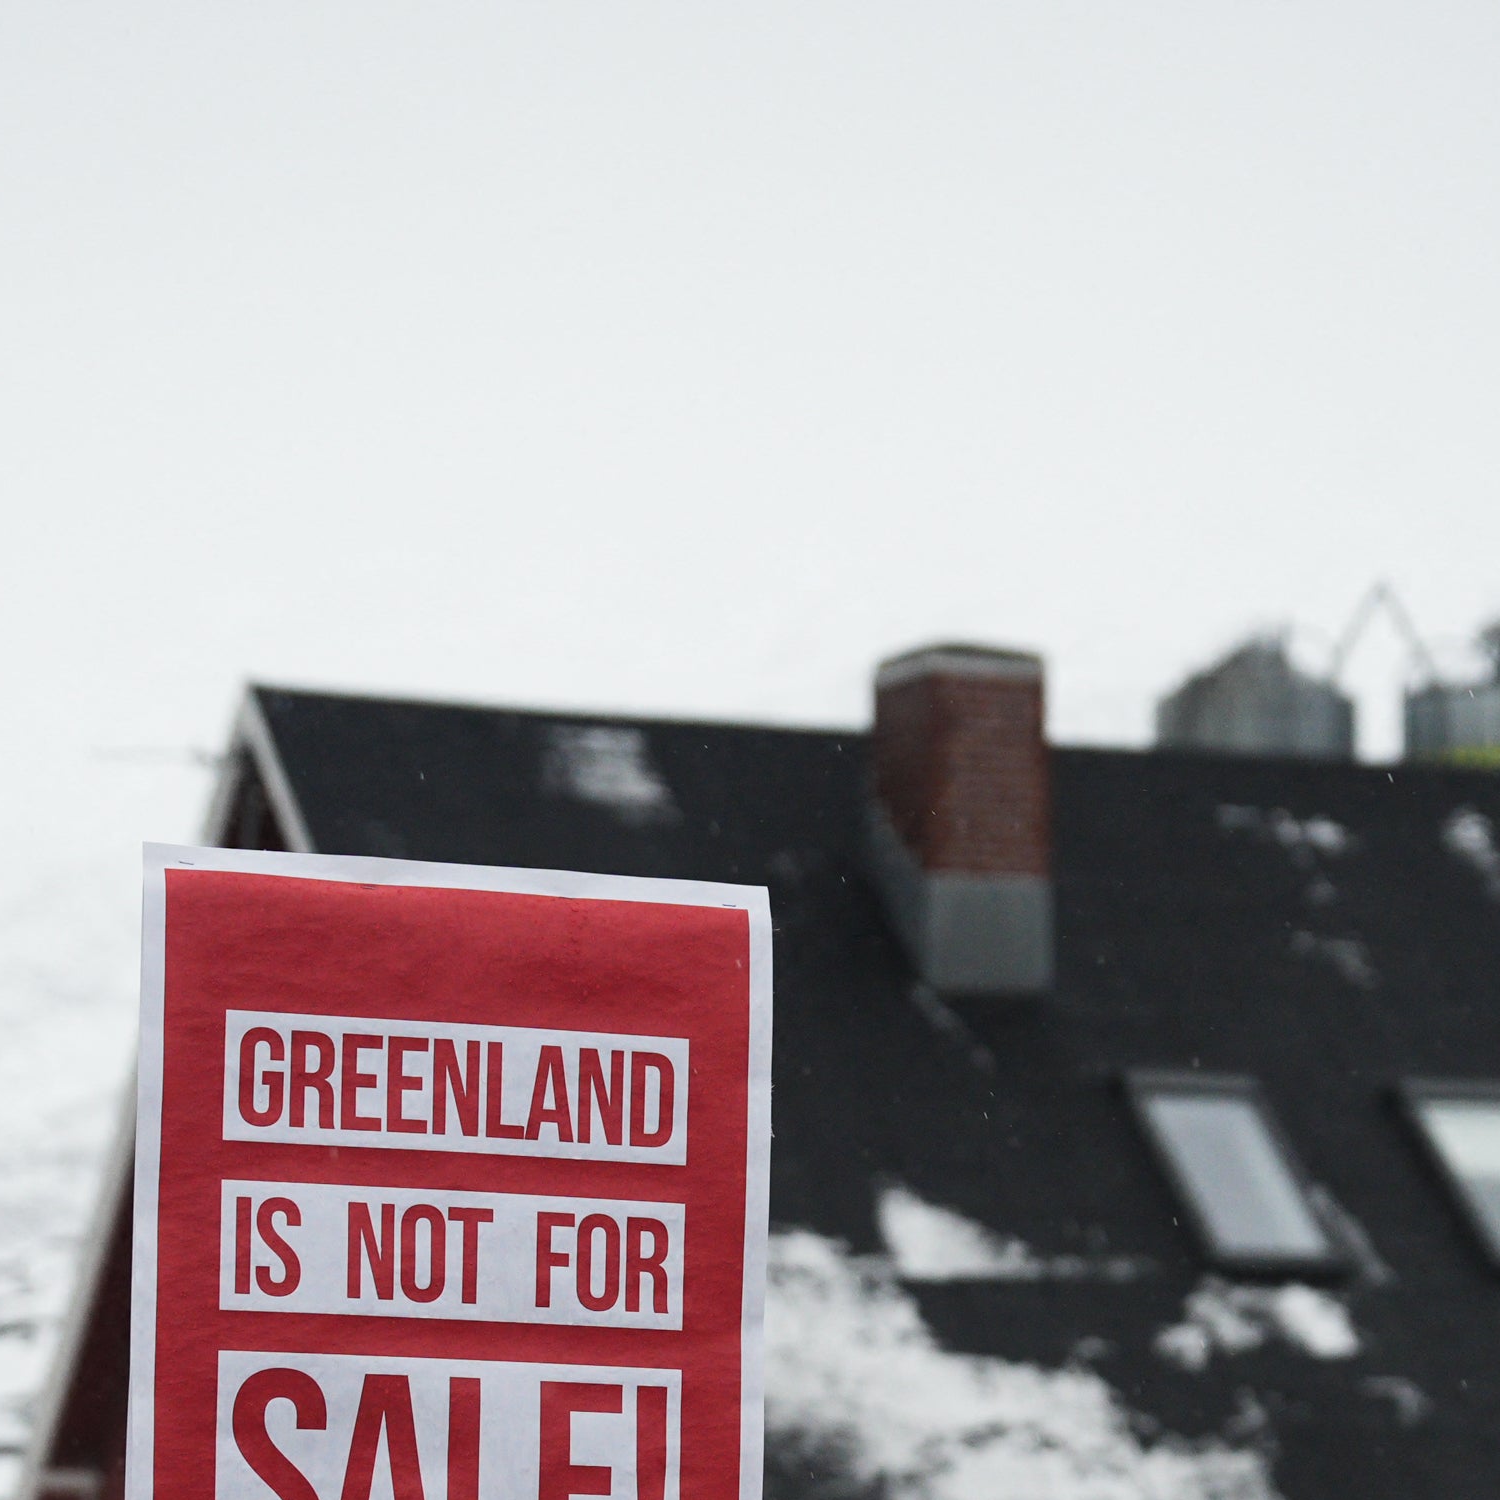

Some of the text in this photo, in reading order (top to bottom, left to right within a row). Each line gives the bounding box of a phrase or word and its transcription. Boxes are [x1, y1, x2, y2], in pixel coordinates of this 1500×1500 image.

[238, 1026, 675, 1147] GREENLAND
[236, 1197, 668, 1313] IS NOT FOR
